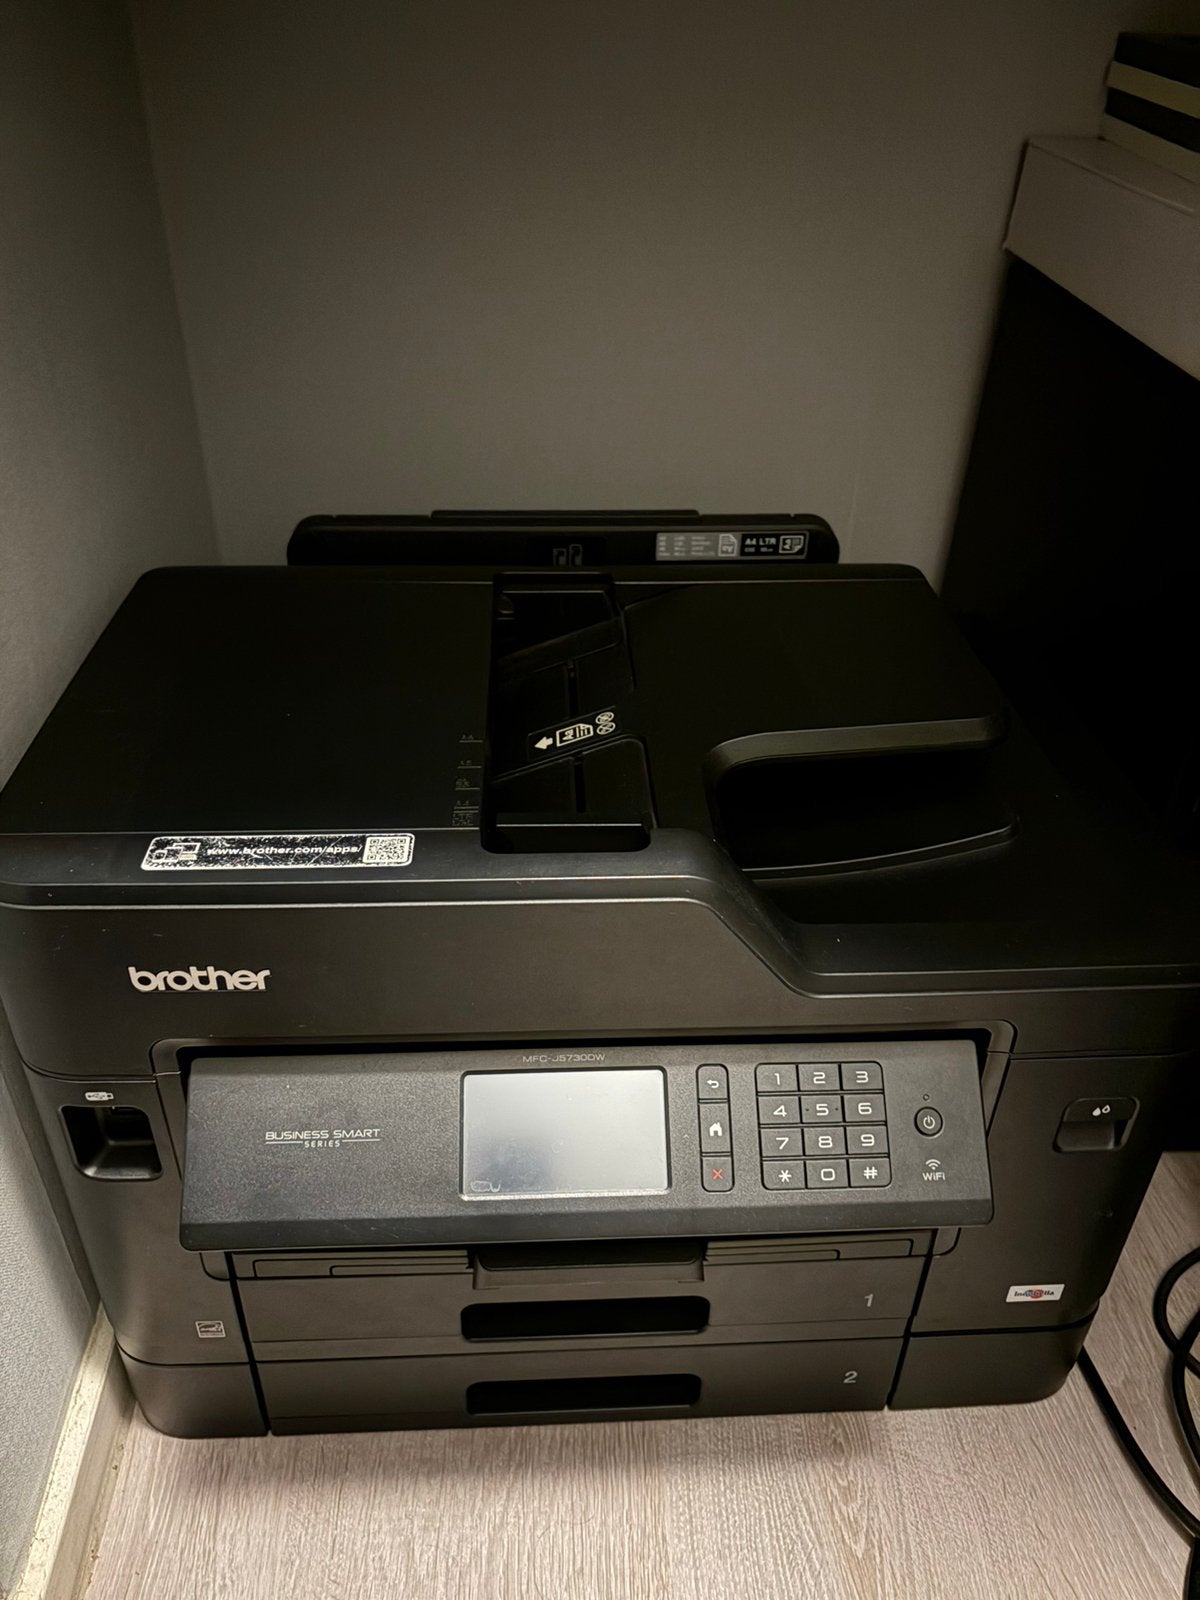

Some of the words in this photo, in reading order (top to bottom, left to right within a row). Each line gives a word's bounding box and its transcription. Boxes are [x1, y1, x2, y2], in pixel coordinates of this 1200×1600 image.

[127, 966, 271, 992] brother
[522, 1053, 606, 1064] MFC-J5730DW
[773, 1072, 781, 1085] 1
[812, 1071, 826, 1085] 2
[855, 1070, 869, 1083] 3
[772, 1104, 788, 1117] 4
[815, 1103, 830, 1116] 5
[857, 1102, 873, 1115] 6
[264, 1130, 329, 1141] BUSINESS
[333, 1128, 382, 1140] SMART
[860, 1133, 875, 1147] 9
[304, 1139, 341, 1149] SERIES
[775, 1136, 790, 1150] 7
[817, 1135, 833, 1149] 8
[820, 1167, 836, 1181] 0
[922, 1171, 946, 1181] WiFi
[864, 1293, 874, 1308] 1
[842, 1370, 858, 1384] 2
